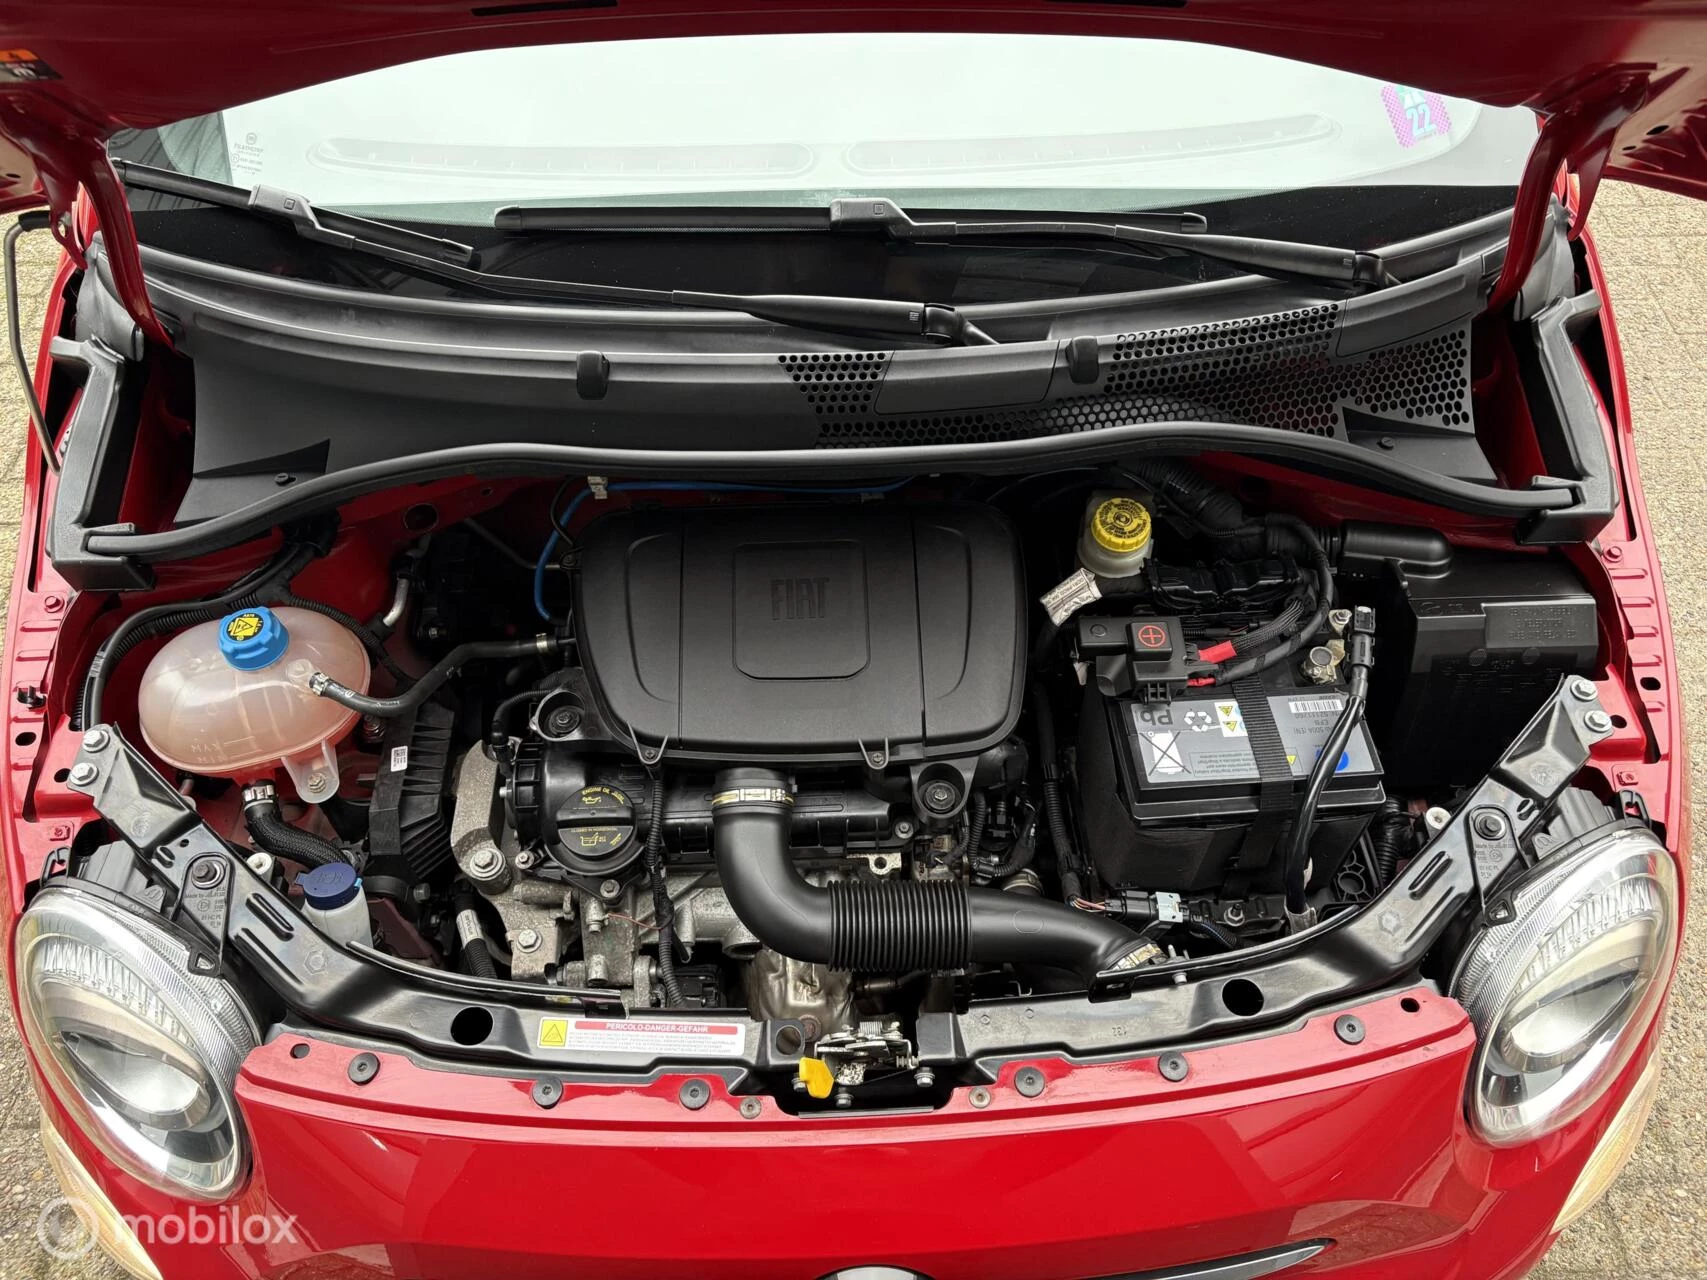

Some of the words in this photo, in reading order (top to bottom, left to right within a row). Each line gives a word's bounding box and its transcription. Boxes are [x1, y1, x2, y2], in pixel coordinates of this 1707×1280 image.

[1405, 102, 1437, 137] 22
[771, 576, 830, 621] FIAT
[1140, 709, 1173, 726] Pb
[582, 787, 602, 795] ENGINE
[606, 1022, 708, 1033] PERICOLO-DANGER-GEFAHR
